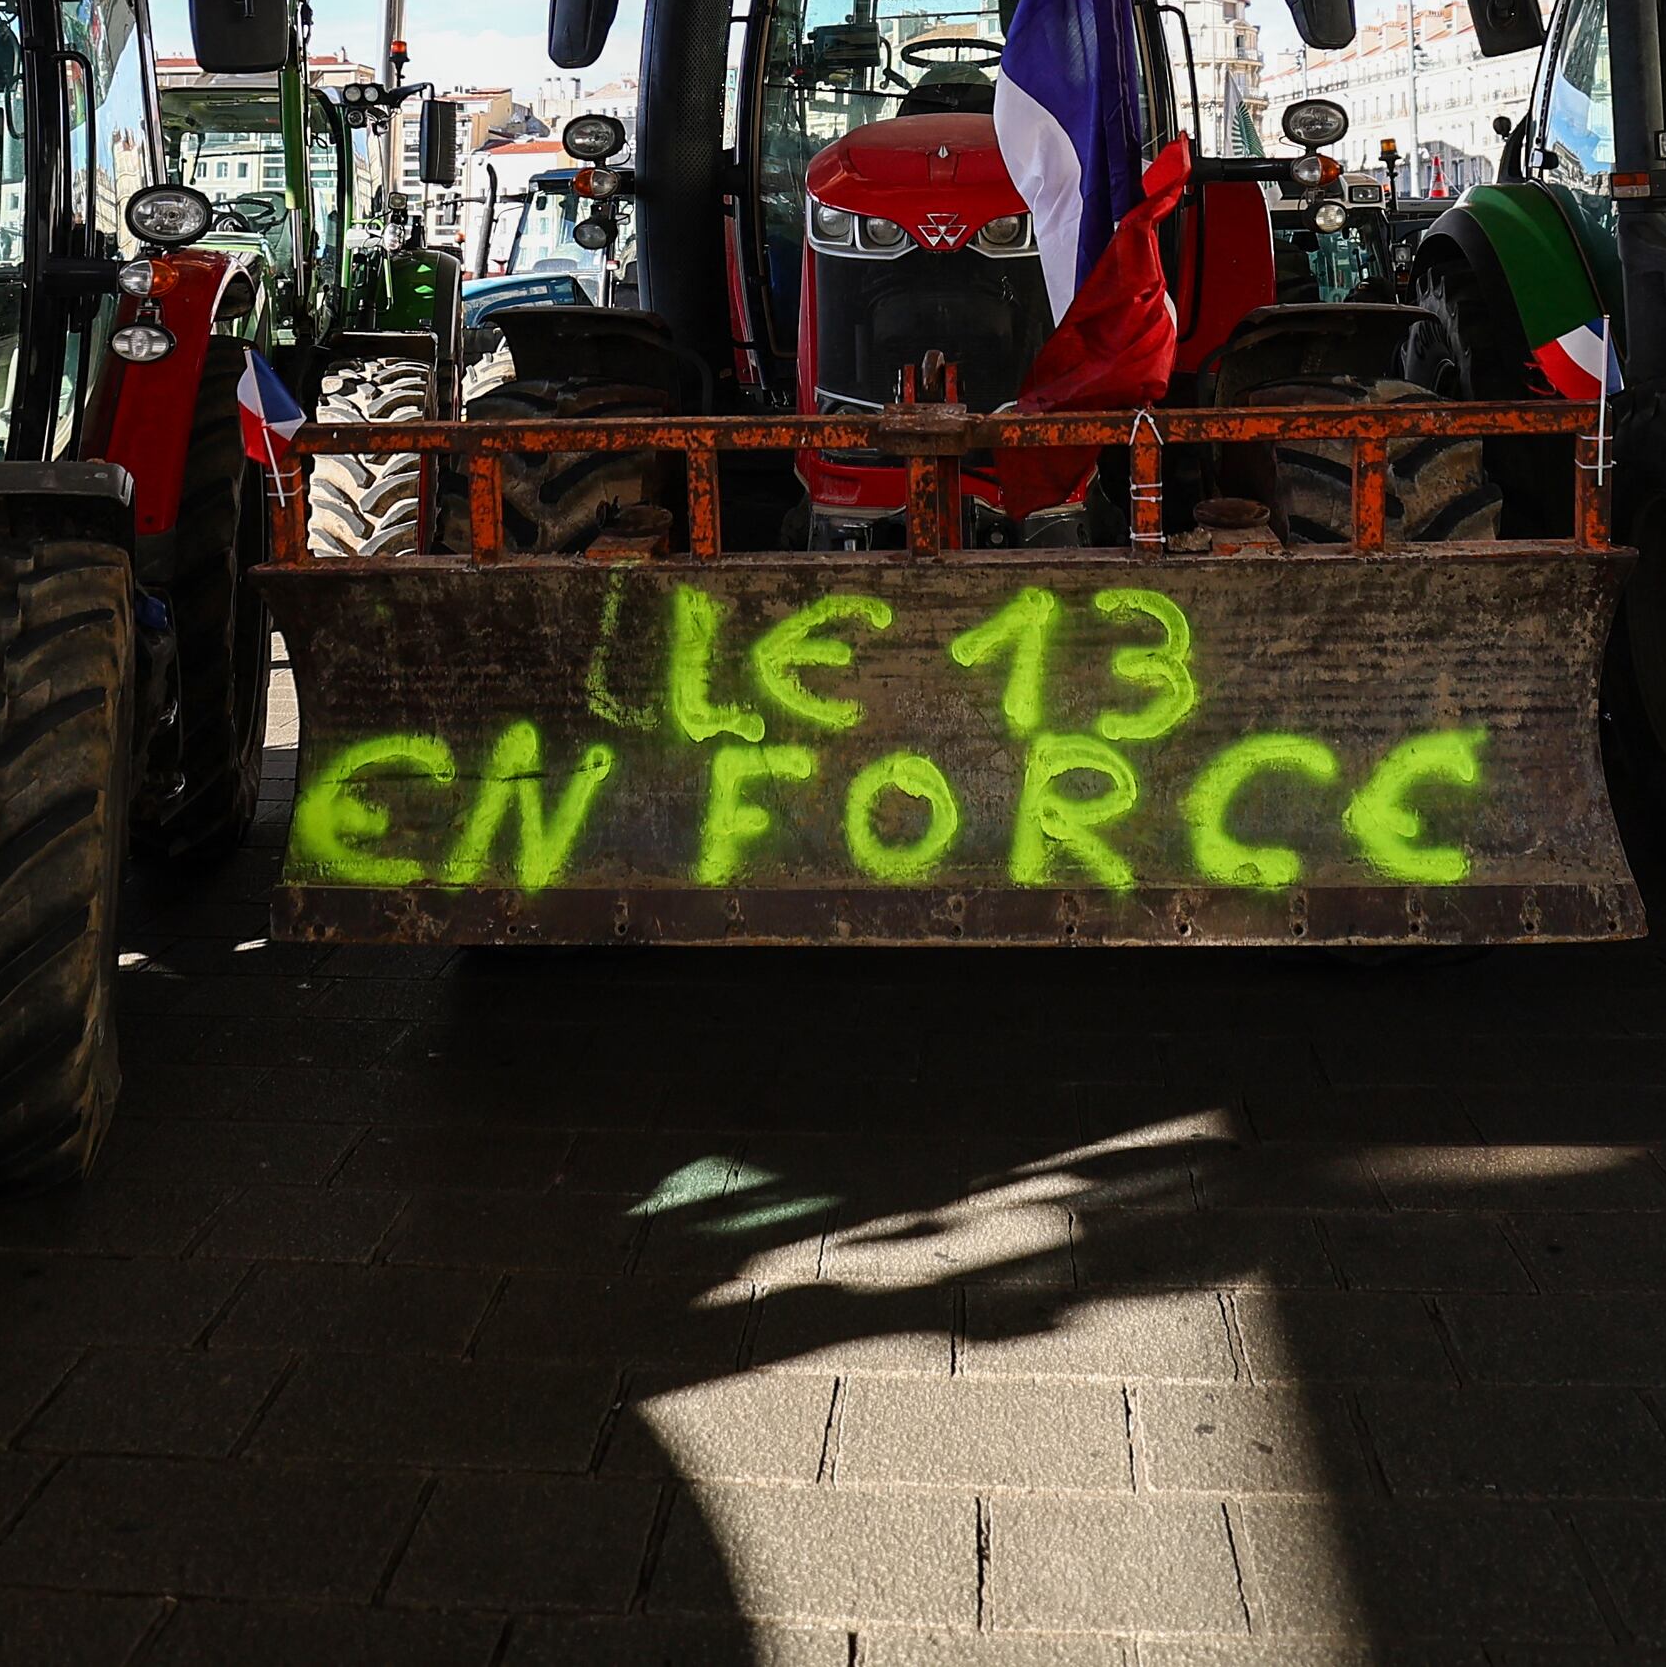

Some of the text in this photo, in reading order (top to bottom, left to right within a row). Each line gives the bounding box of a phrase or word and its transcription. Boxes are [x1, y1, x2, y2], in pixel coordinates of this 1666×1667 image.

[670, 586, 1200, 743] LE 13
[297, 722, 1487, 892] EN FORCE
